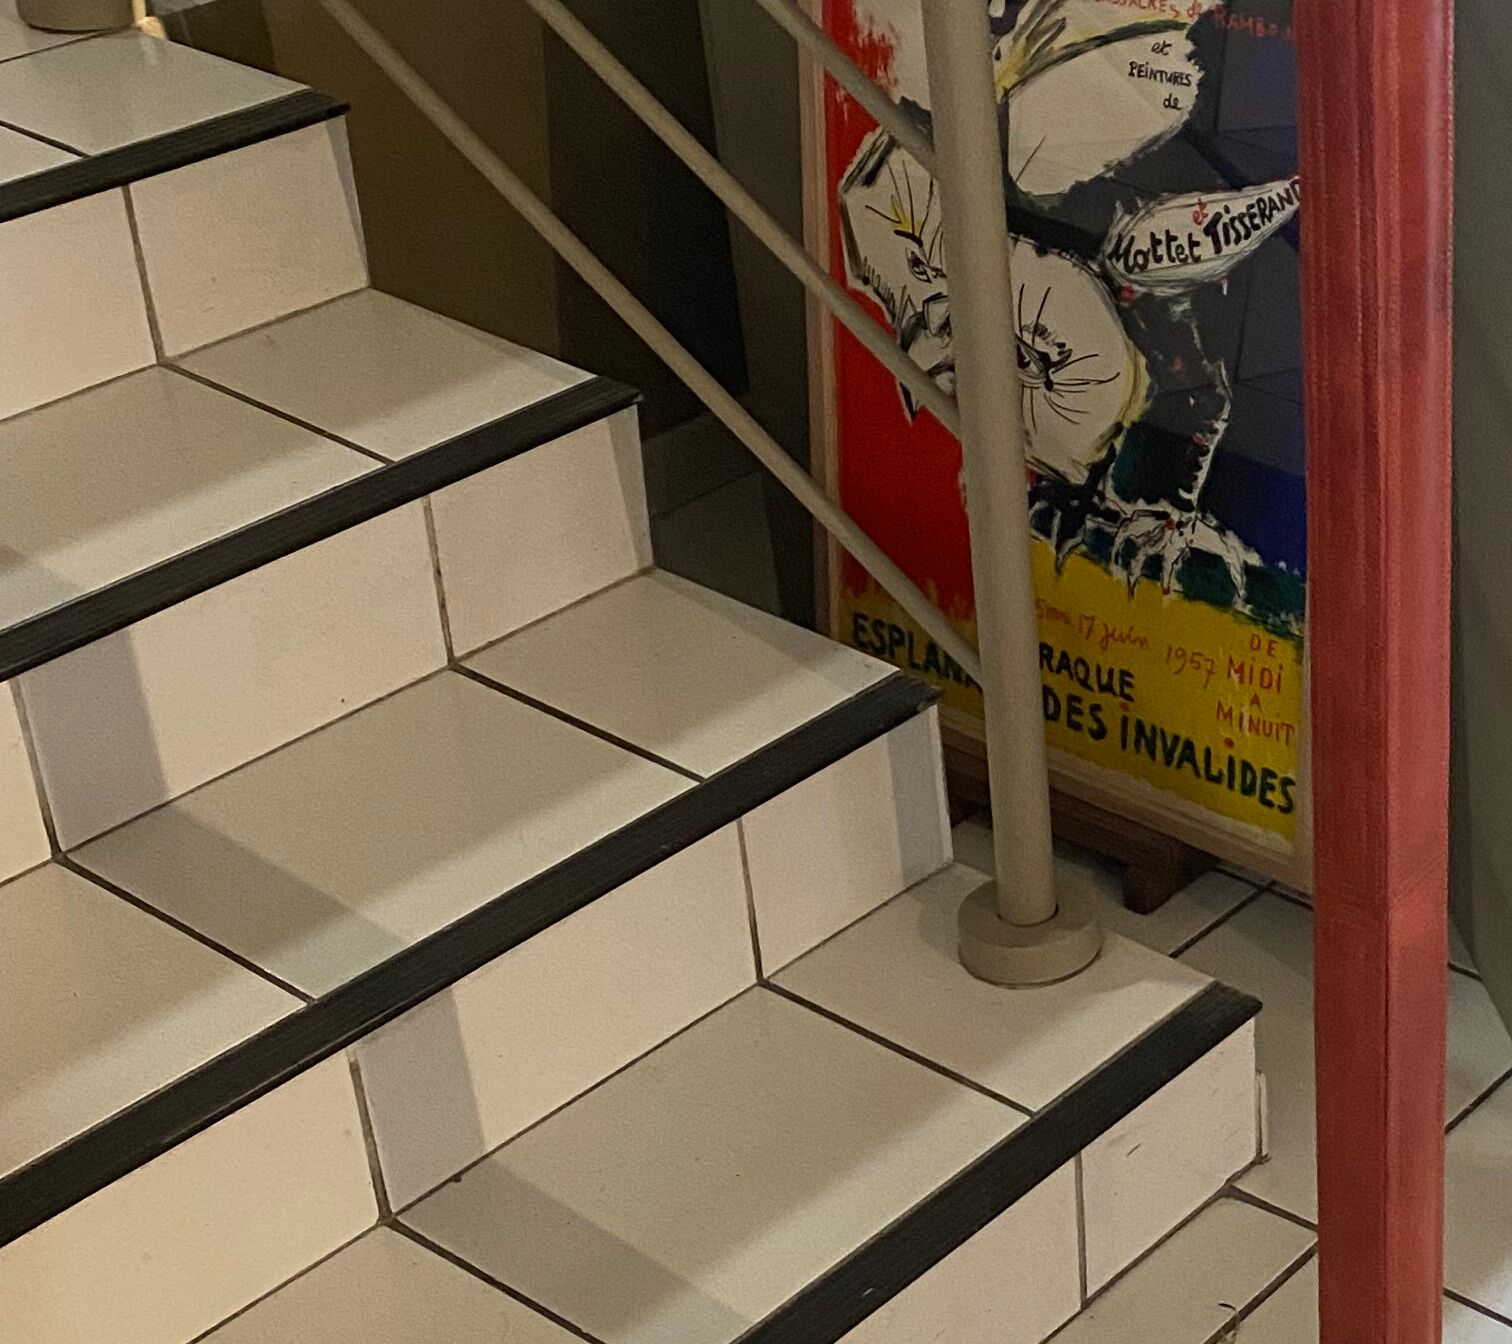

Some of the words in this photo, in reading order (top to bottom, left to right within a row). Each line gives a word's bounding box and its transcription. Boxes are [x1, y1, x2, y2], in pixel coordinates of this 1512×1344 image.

[1151, 40, 1172, 56] et
[1163, 93, 1184, 111] de
[1250, 633, 1279, 657] DE
[1166, 645, 1216, 690] 1957
[1041, 684, 1108, 741] DES
